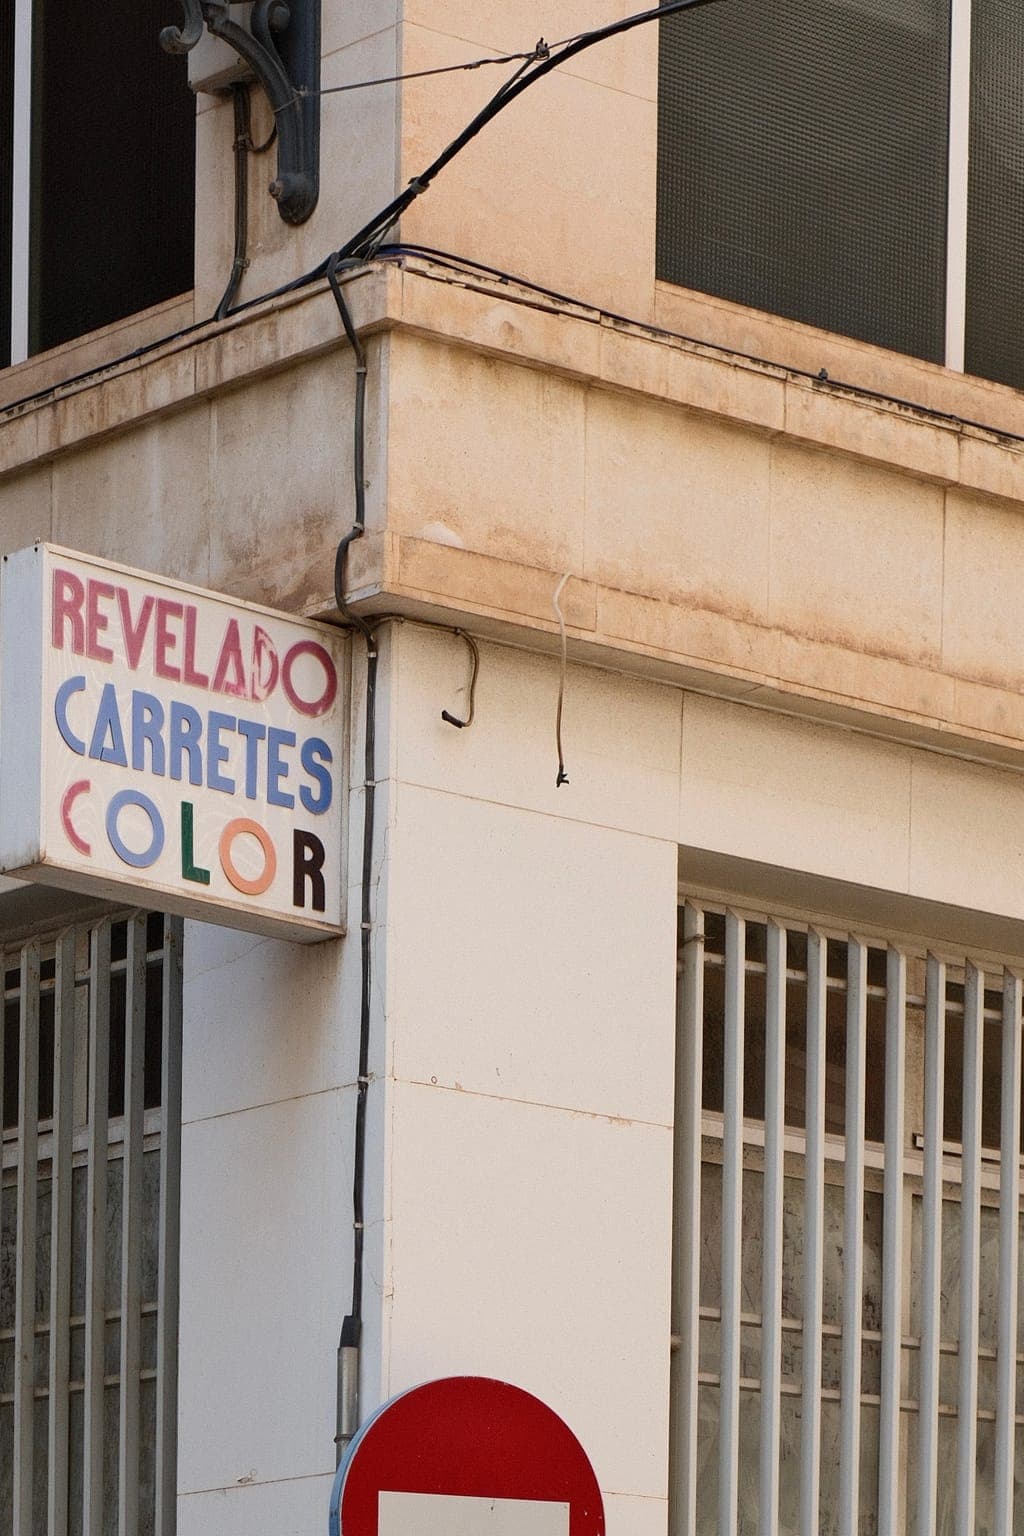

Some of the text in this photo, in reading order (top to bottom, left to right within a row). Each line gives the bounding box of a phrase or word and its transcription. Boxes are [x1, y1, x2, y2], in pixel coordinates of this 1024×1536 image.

[51, 568, 338, 717] REVELADO
[54, 675, 333, 815] CARRETES
[60, 779, 326, 912] COLOR
